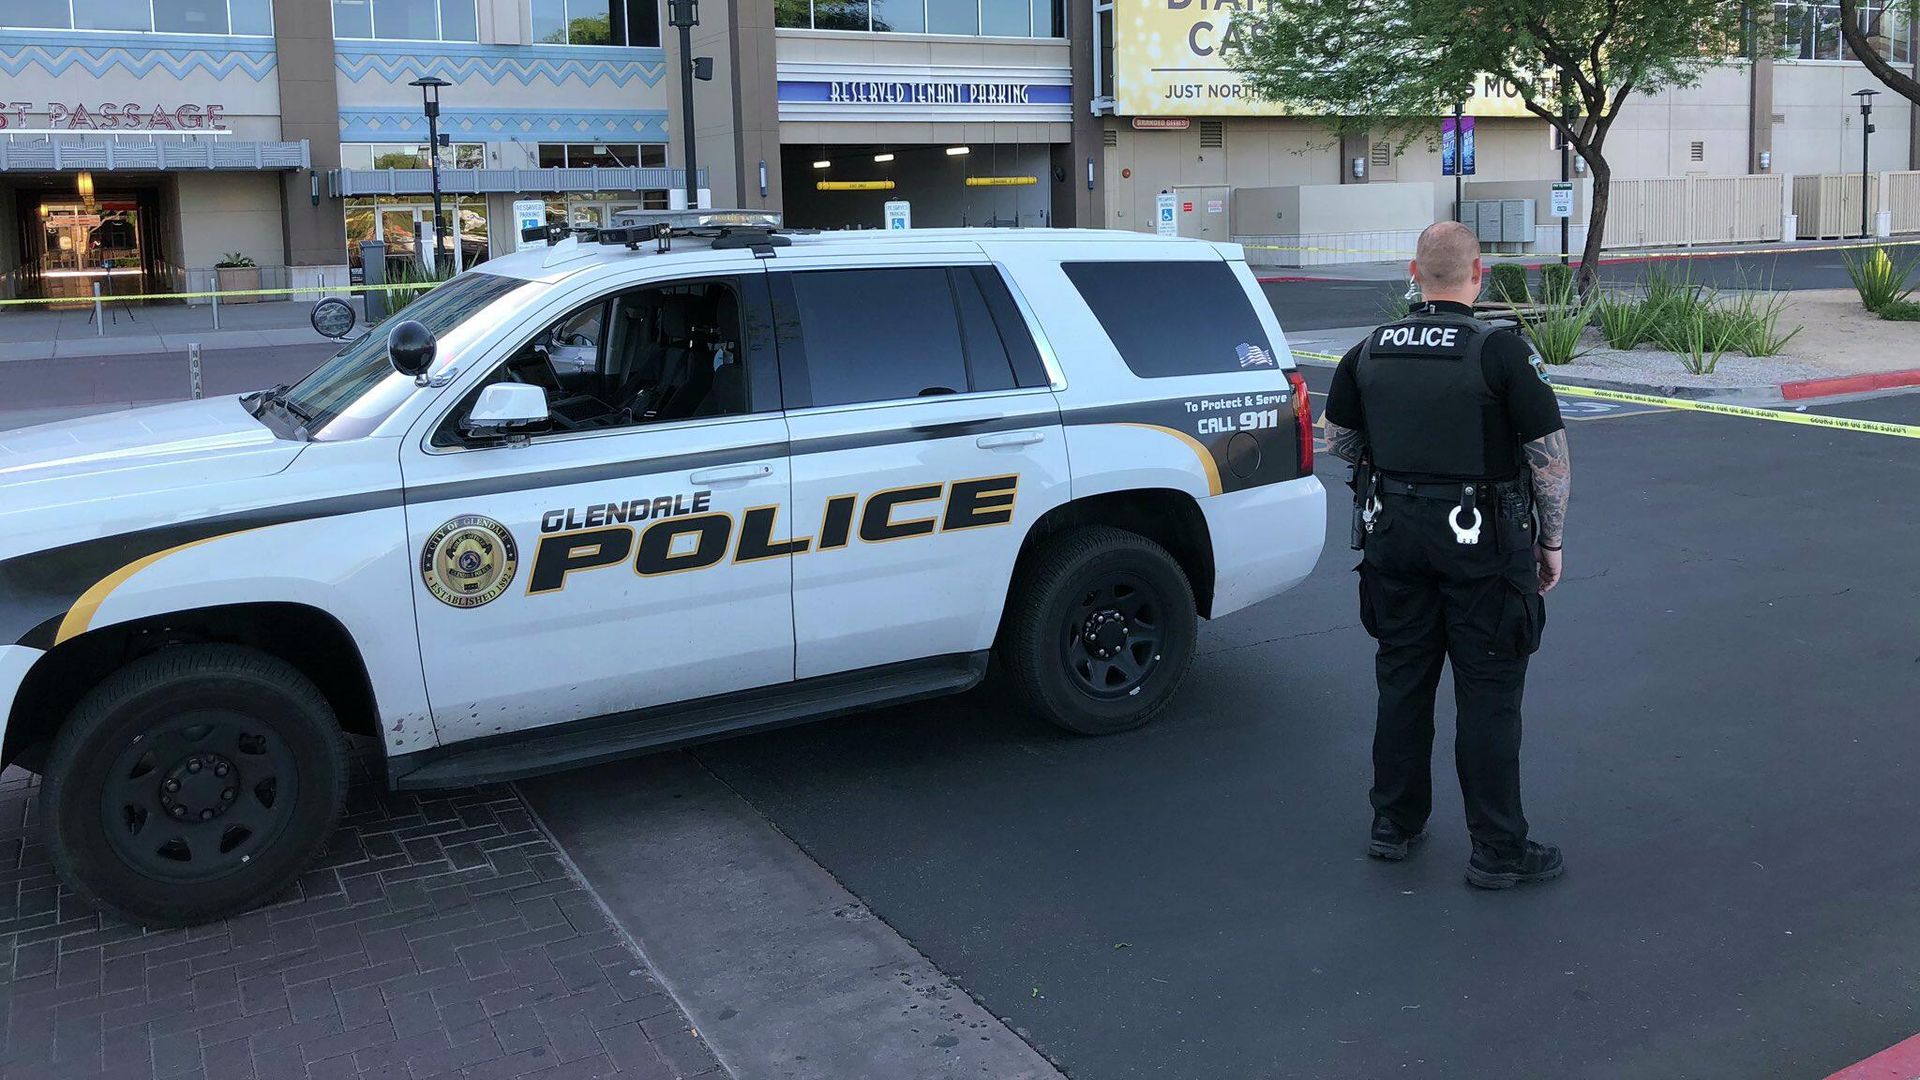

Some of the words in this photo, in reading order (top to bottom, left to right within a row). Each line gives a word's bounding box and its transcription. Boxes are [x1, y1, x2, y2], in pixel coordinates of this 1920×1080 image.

[830, 81, 904, 103] RESERVED
[910, 82, 962, 104] TENANT
[970, 84, 1029, 104] PARKING
[1165, 84, 1203, 98] JUST
[1208, 84, 1261, 98] NORTH
[48, 102, 226, 130] PASSAGE
[1379, 327, 1458, 347] POLICE
[1184, 401, 1199, 413] To
[1201, 396, 1242, 411] Protect
[1244, 395, 1254, 406] &
[1255, 394, 1288, 405] Serve
[1197, 416, 1237, 434] CALL
[1239, 408, 1278, 431] 911
[541, 489, 711, 533] GLENDALE
[429, 530, 446, 550] CITY
[447, 520, 460, 531] OF
[463, 517, 509, 541] GLENDALE
[524, 472, 1020, 597] POLICE
[430, 582, 496, 606] ESTABLISHED
[496, 573, 512, 591] 1892
